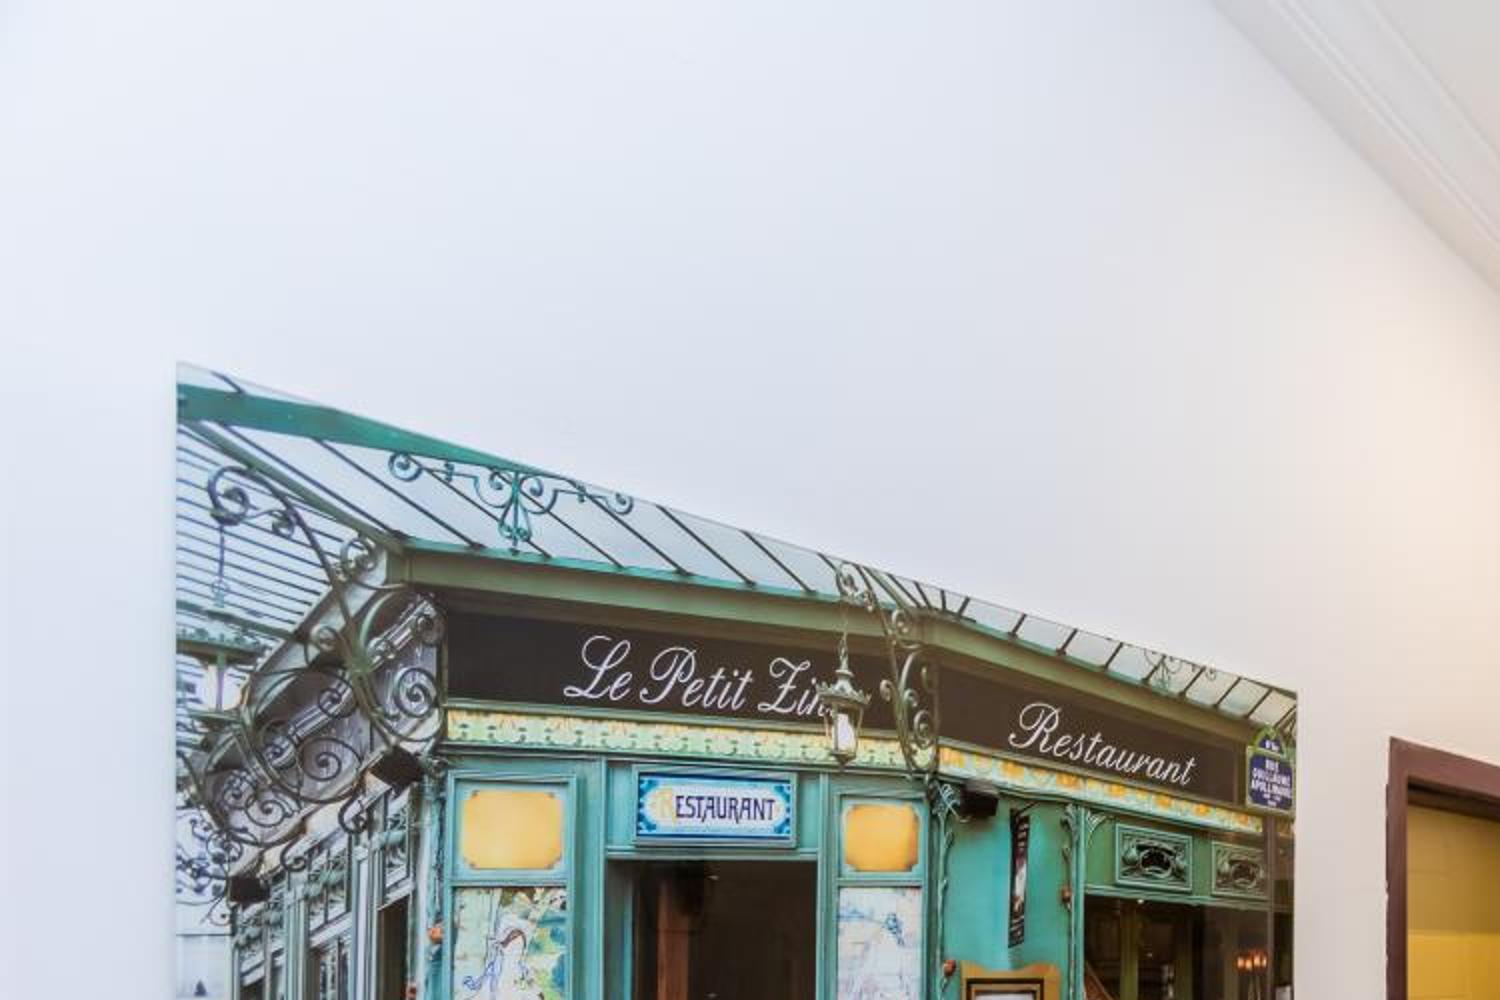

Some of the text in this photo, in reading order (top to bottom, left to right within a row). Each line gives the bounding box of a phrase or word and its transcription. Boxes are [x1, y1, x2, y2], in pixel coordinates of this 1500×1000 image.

[563, 634, 633, 701] Le
[639, 646, 755, 711] Petit
[1007, 701, 1197, 787] Restaurant
